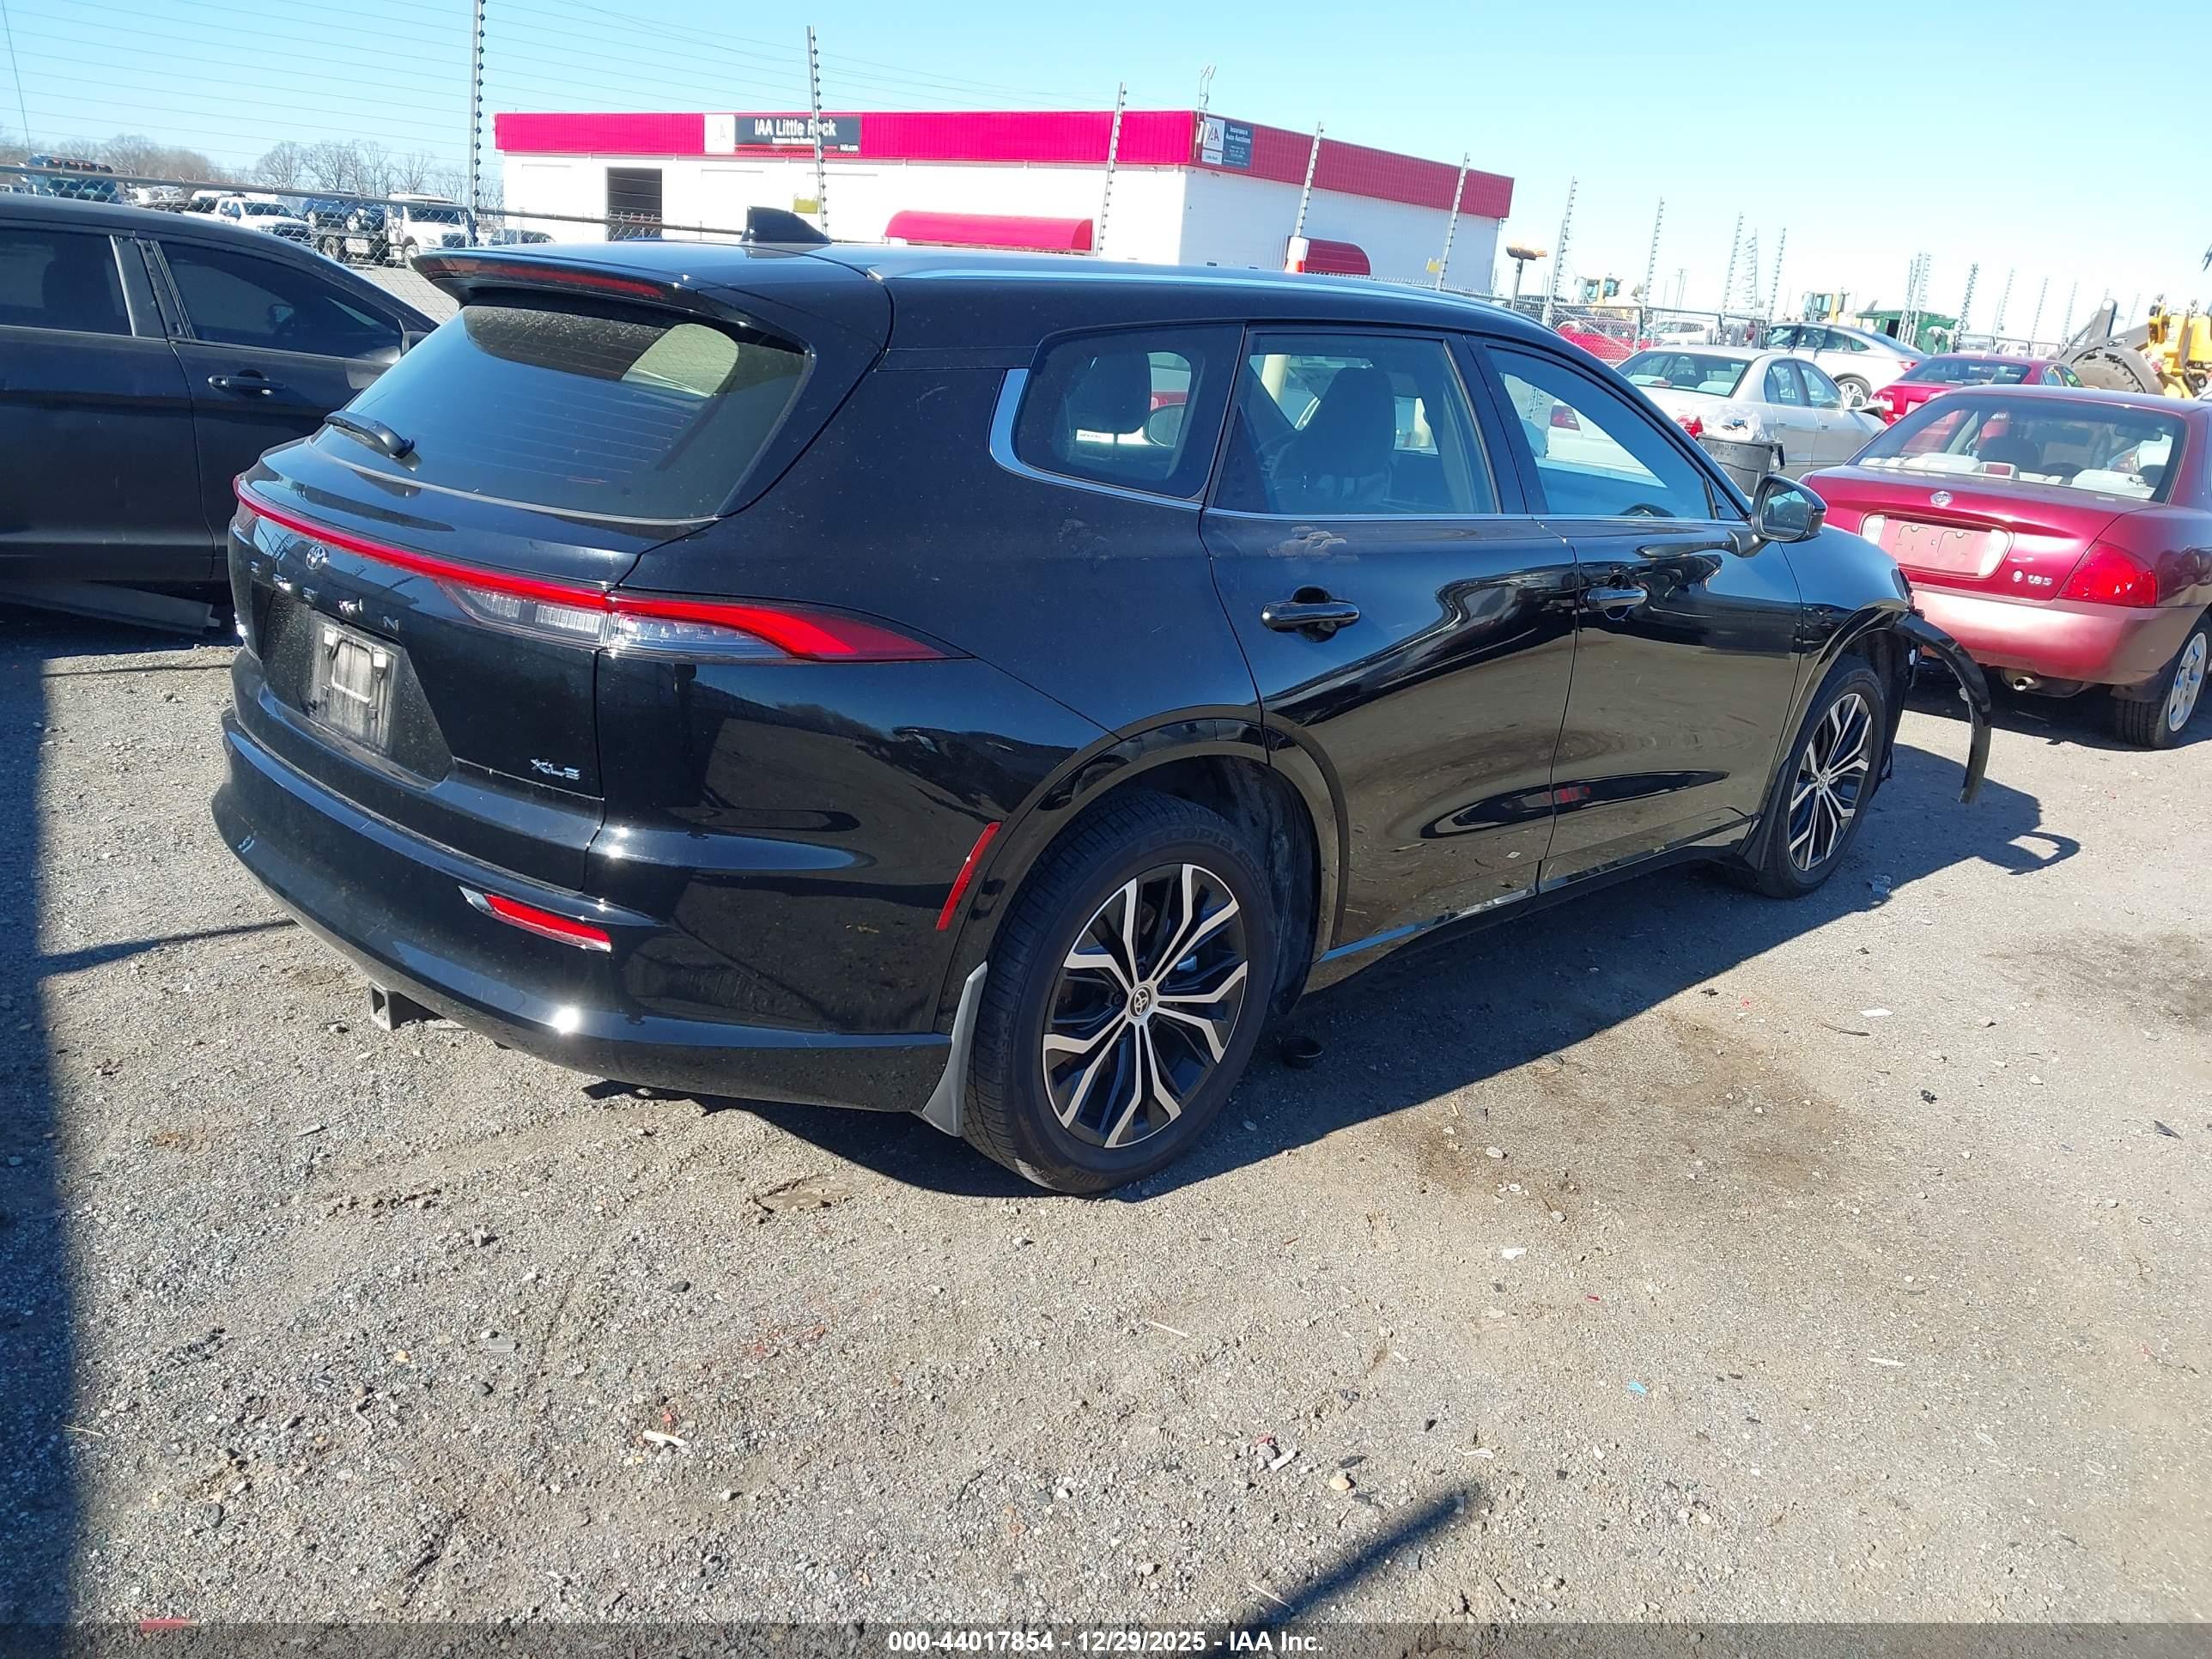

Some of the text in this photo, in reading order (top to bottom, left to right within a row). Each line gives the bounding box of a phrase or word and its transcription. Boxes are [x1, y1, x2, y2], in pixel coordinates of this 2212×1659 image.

[755, 118, 774, 136] IAA
[775, 118, 805, 136] Little
[529, 758, 580, 781] XLE
